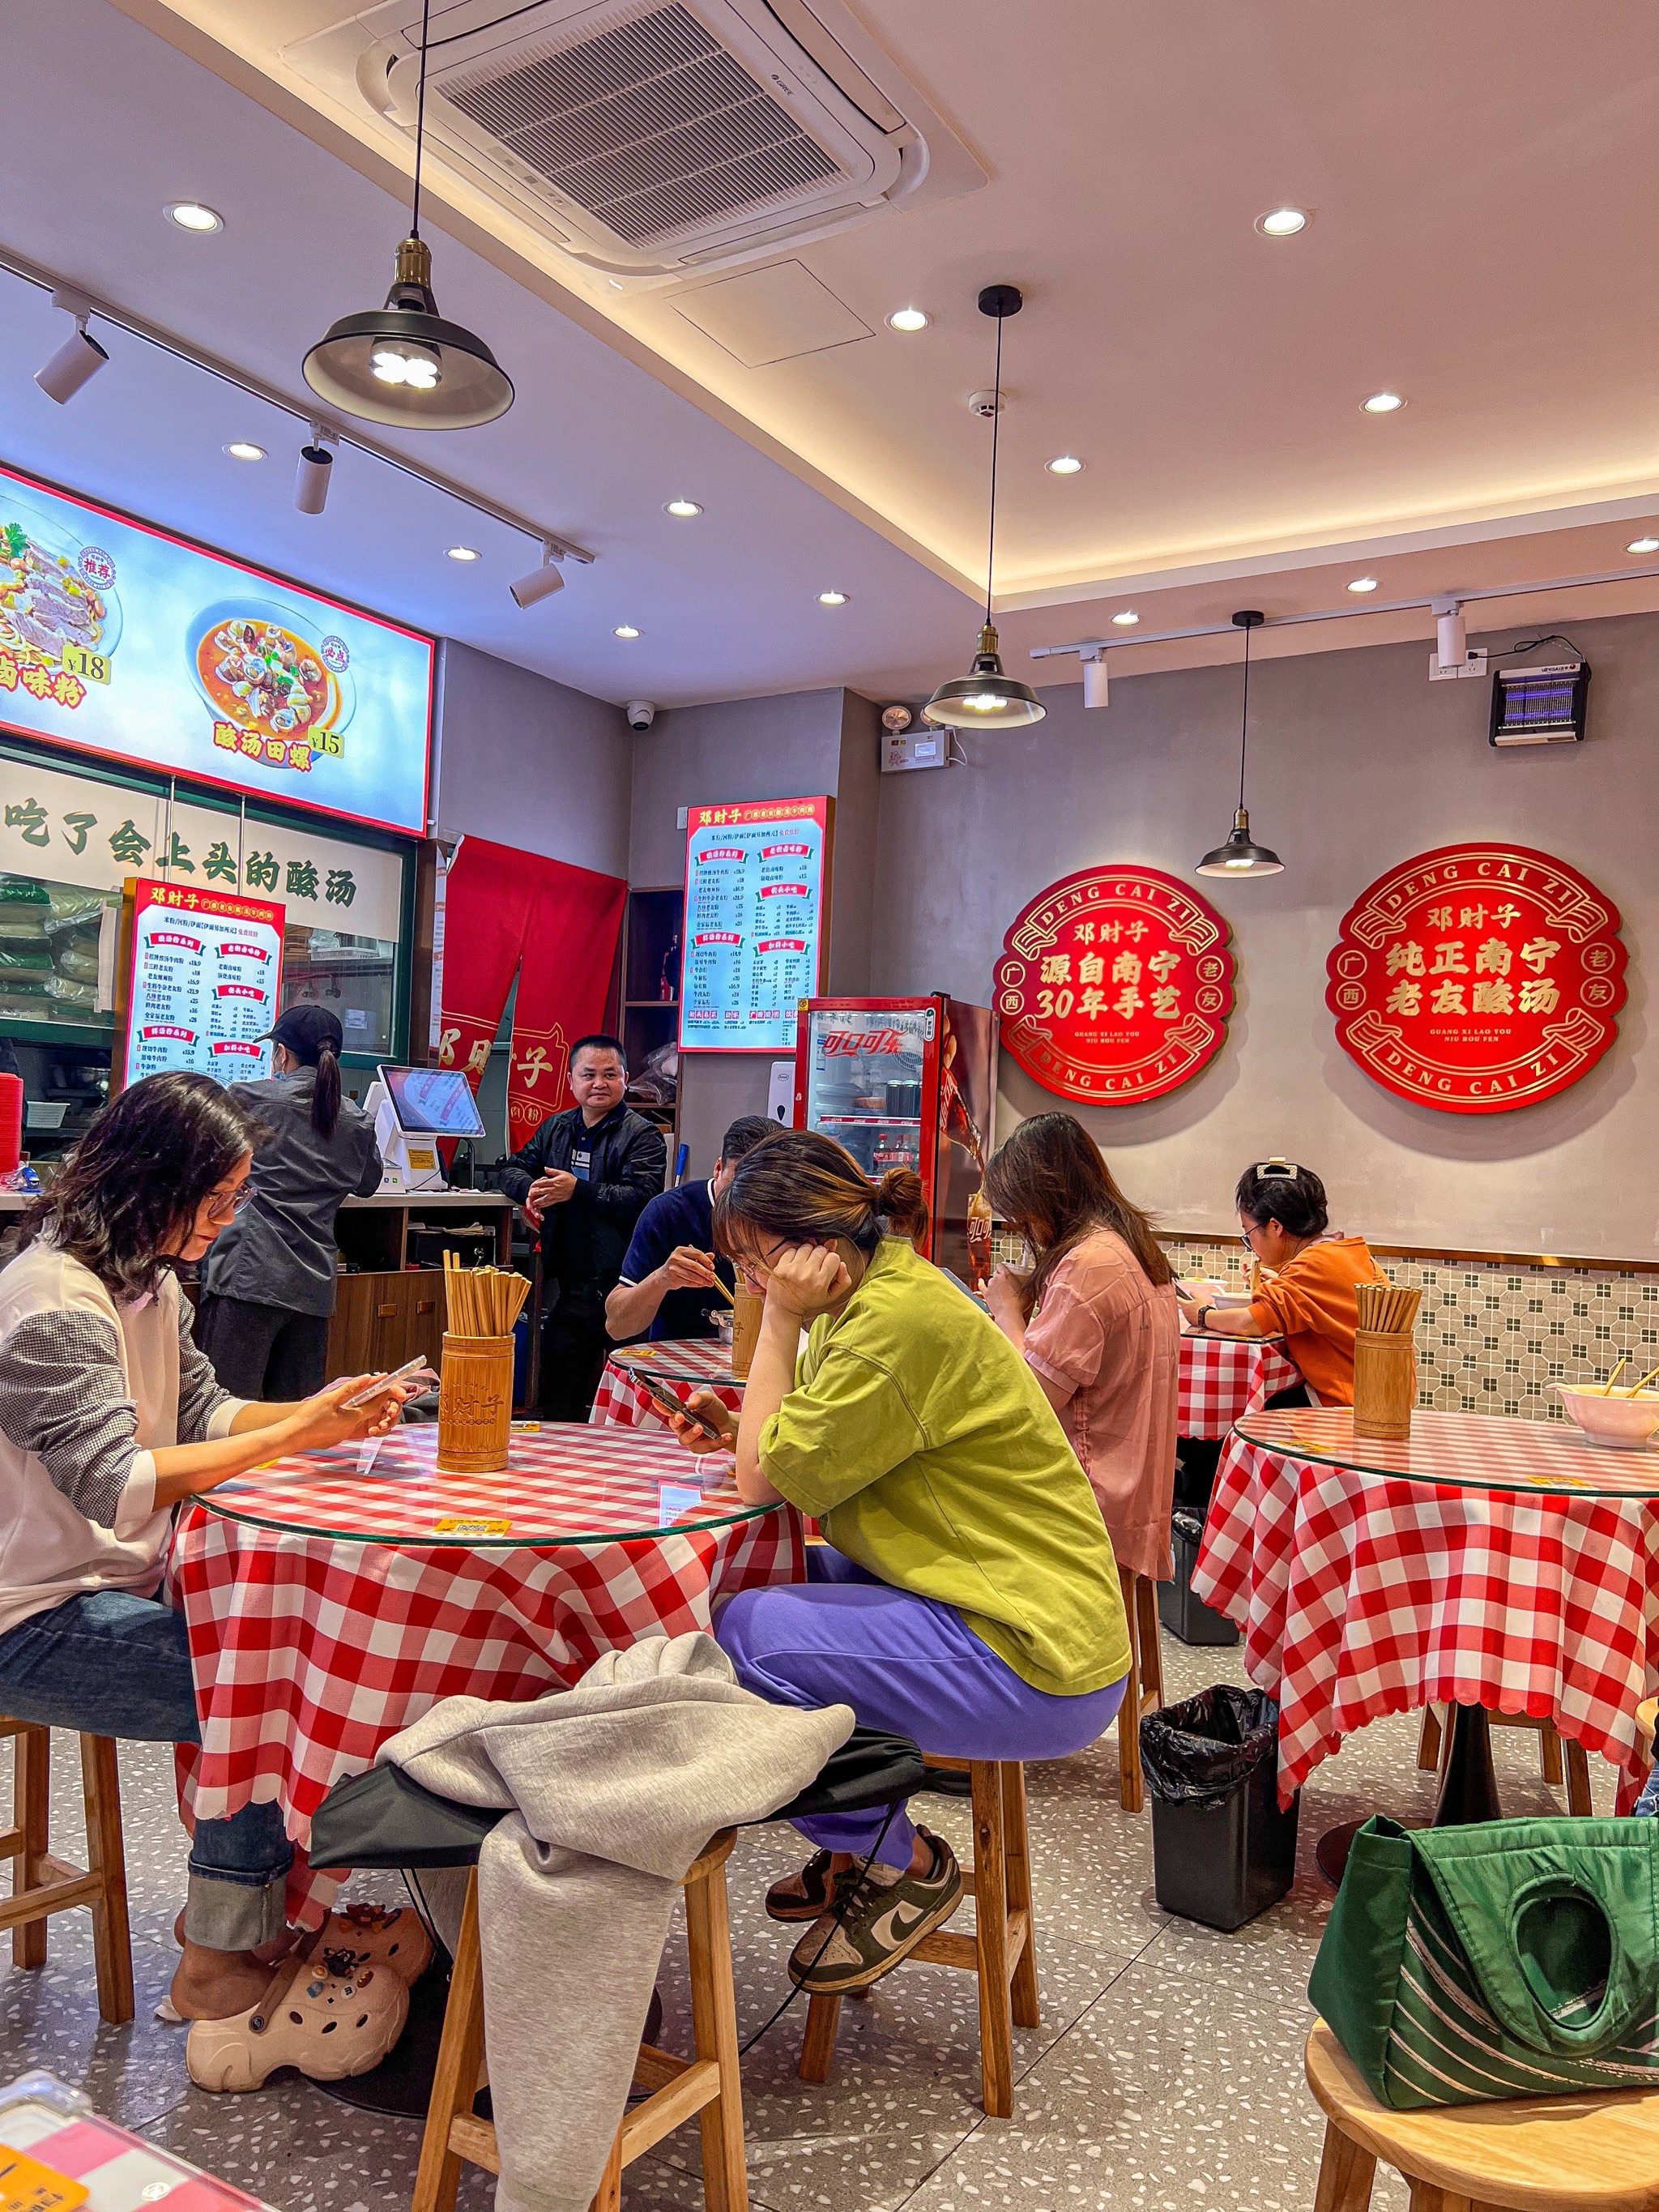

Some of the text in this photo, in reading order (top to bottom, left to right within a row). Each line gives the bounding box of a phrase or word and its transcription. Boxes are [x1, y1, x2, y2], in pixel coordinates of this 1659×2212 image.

[83, 558, 110, 579] 推荐
[68, 653, 104, 680] ¥18
[215, 722, 311, 771] 酸汤田螺
[312, 732, 339, 755] ¥15
[699, 808, 742, 826] 邓财子
[4, 797, 356, 907] 吃了会上头的酸汤
[151, 887, 199, 909] 邓财子
[1385, 862, 1573, 910] DENG CAI ZI
[1040, 883, 1191, 925] DENG CAI ZI
[1426, 903, 1522, 932] 邓财子
[1073, 920, 1149, 946] 邓财子
[1039, 950, 1181, 985] 源自南宁
[1384, 937, 1562, 977] 纯正南宁
[228, 987, 255, 997] 街头小吃
[1034, 985, 1181, 1021] 30年手艺
[1384, 977, 1561, 1017] 老友酸汤
[822, 1027, 908, 1057] 可口可乐
[1039, 1052, 1178, 1091] DENG CAI ZI
[1384, 1051, 1559, 1095] DENG CAI ZI
[969, 1216, 992, 1243] 可口可
